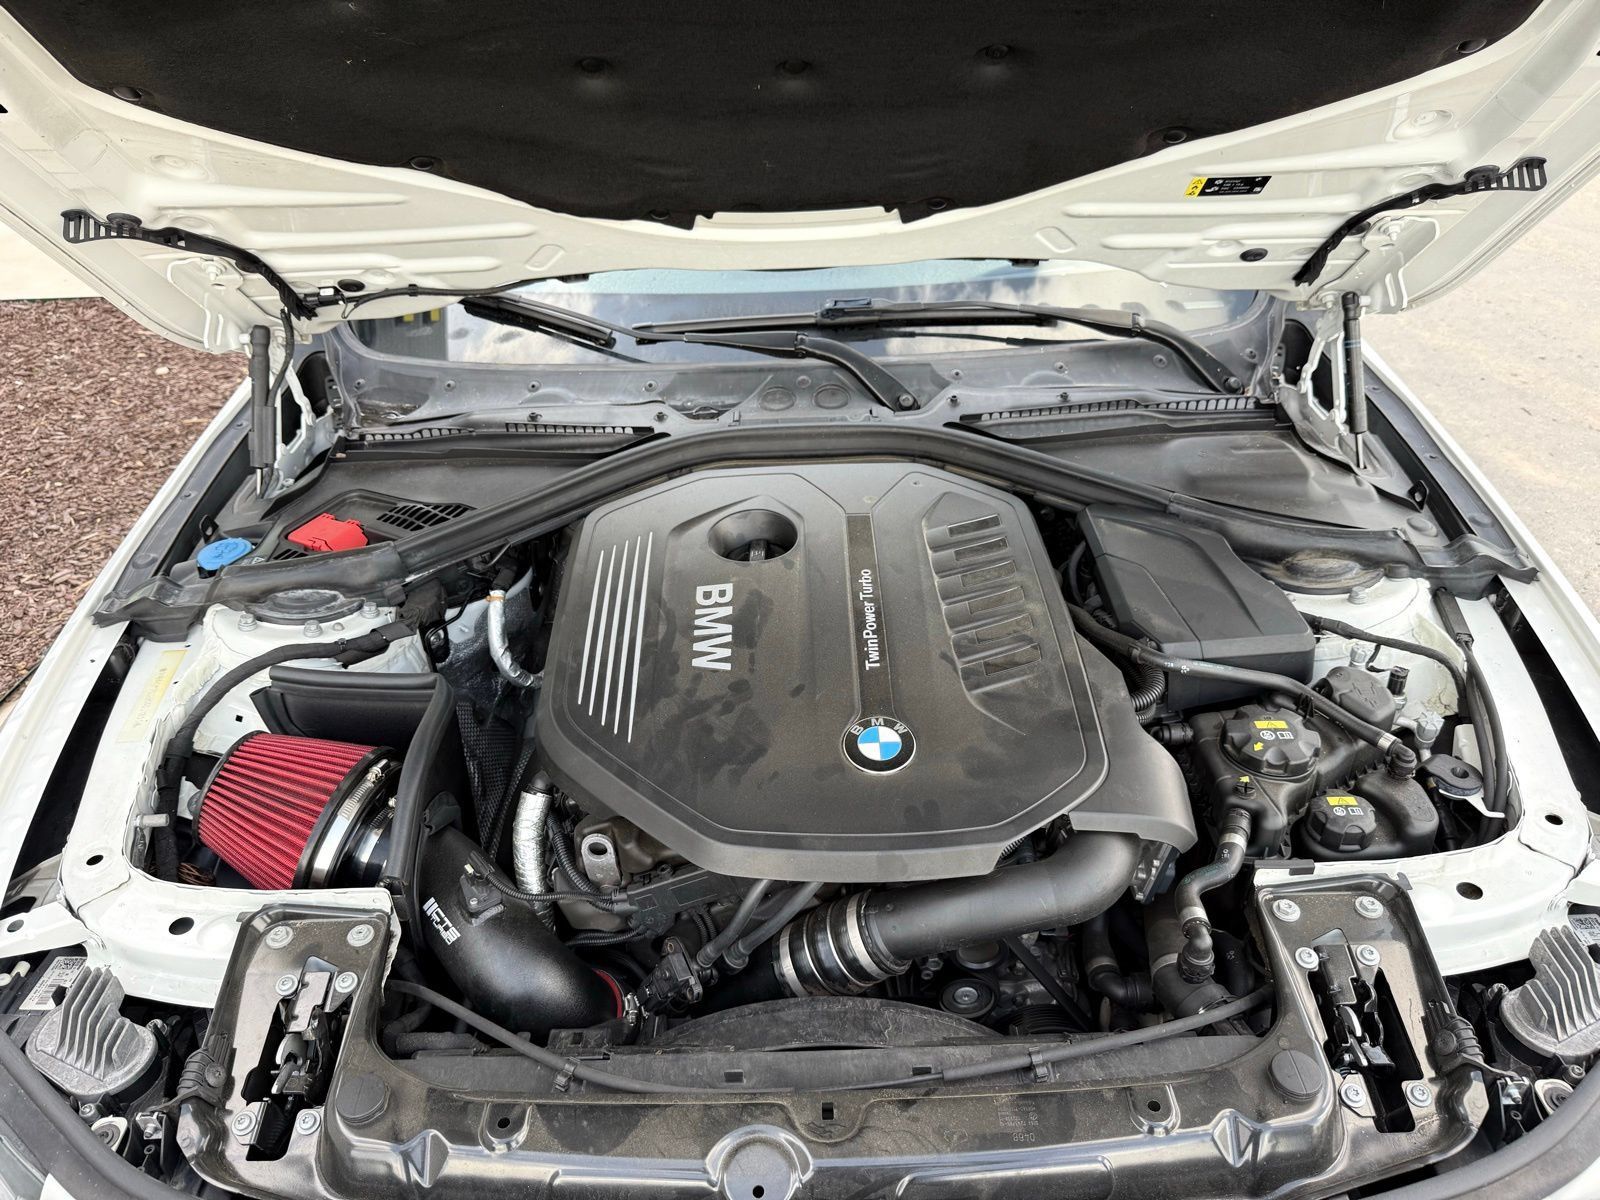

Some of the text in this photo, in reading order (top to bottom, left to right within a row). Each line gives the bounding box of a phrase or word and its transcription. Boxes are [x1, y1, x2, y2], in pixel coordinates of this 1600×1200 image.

[691, 583, 733, 670] BMW
[858, 568, 880, 671] TwinPower Turbo
[850, 717, 908, 736] BMW
